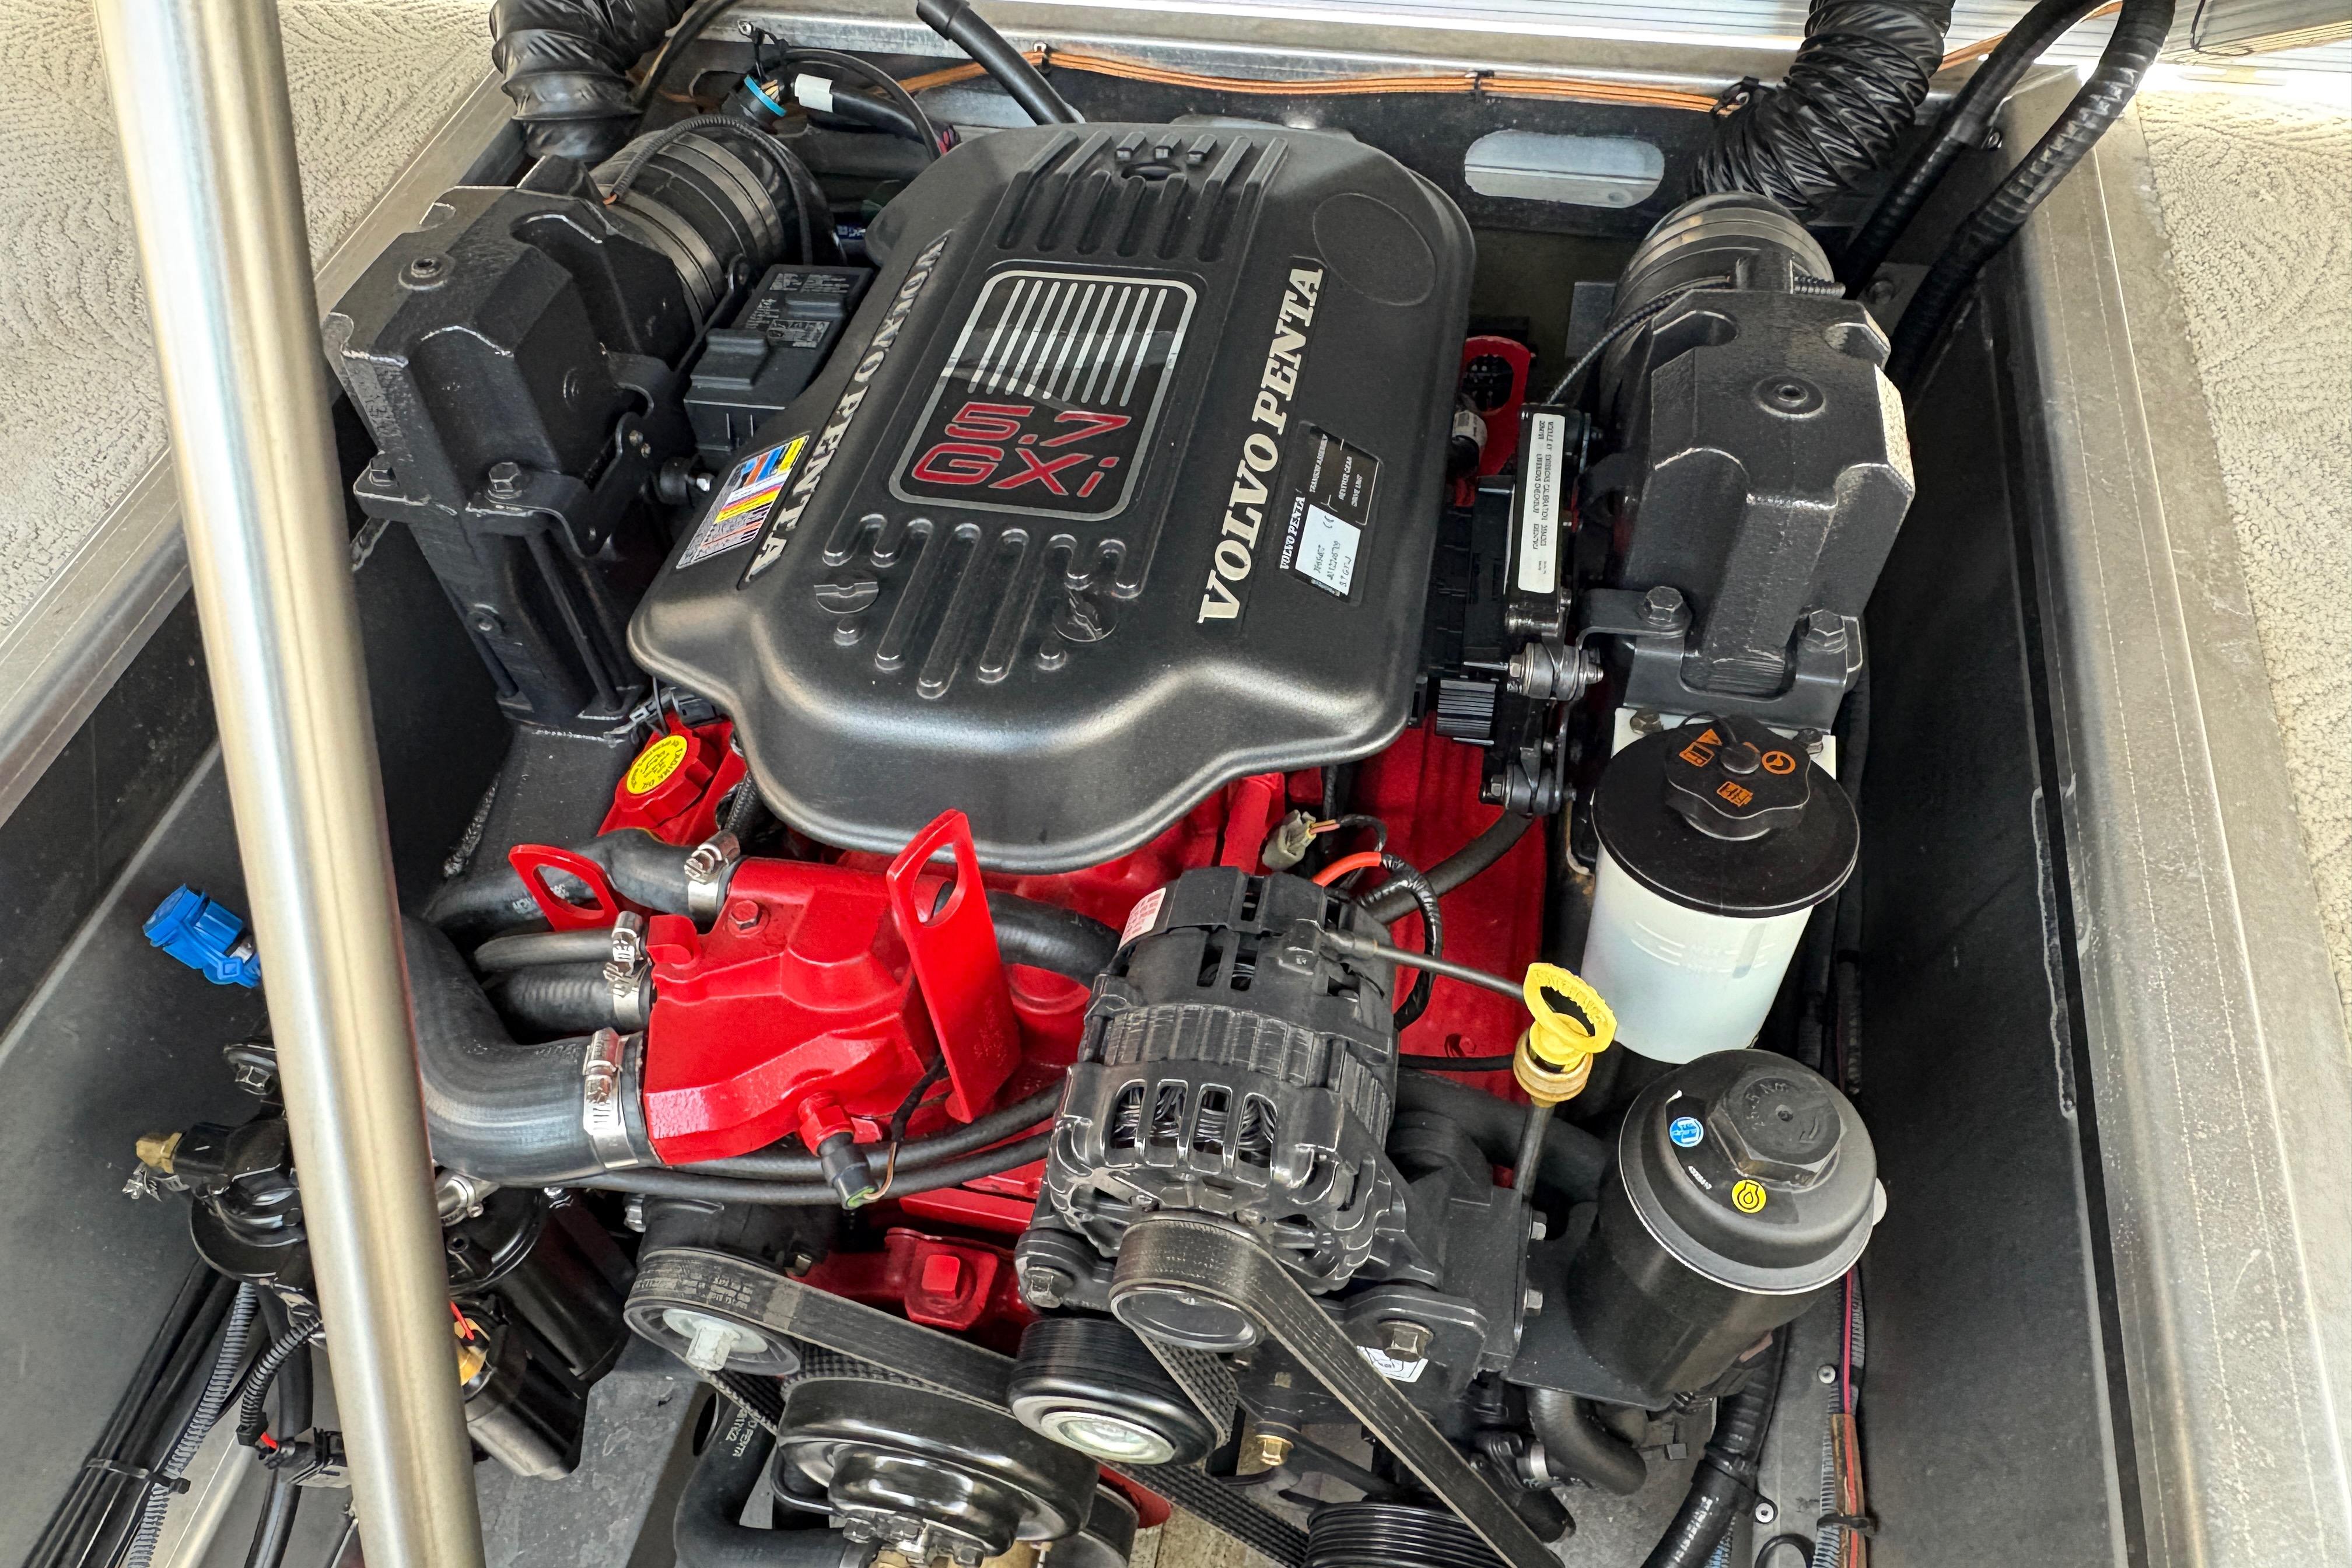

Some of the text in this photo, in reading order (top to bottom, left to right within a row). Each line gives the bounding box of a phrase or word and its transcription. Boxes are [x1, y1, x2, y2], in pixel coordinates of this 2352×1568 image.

[854, 236, 949, 384] VOLVO
[912, 443, 1120, 498] GXi
[944, 401, 1132, 447] 5.7
[1198, 268, 1322, 624] VOLVO PENTA
[744, 385, 869, 583] PENTA
[1280, 496, 1306, 569] VOLVO PENTA
